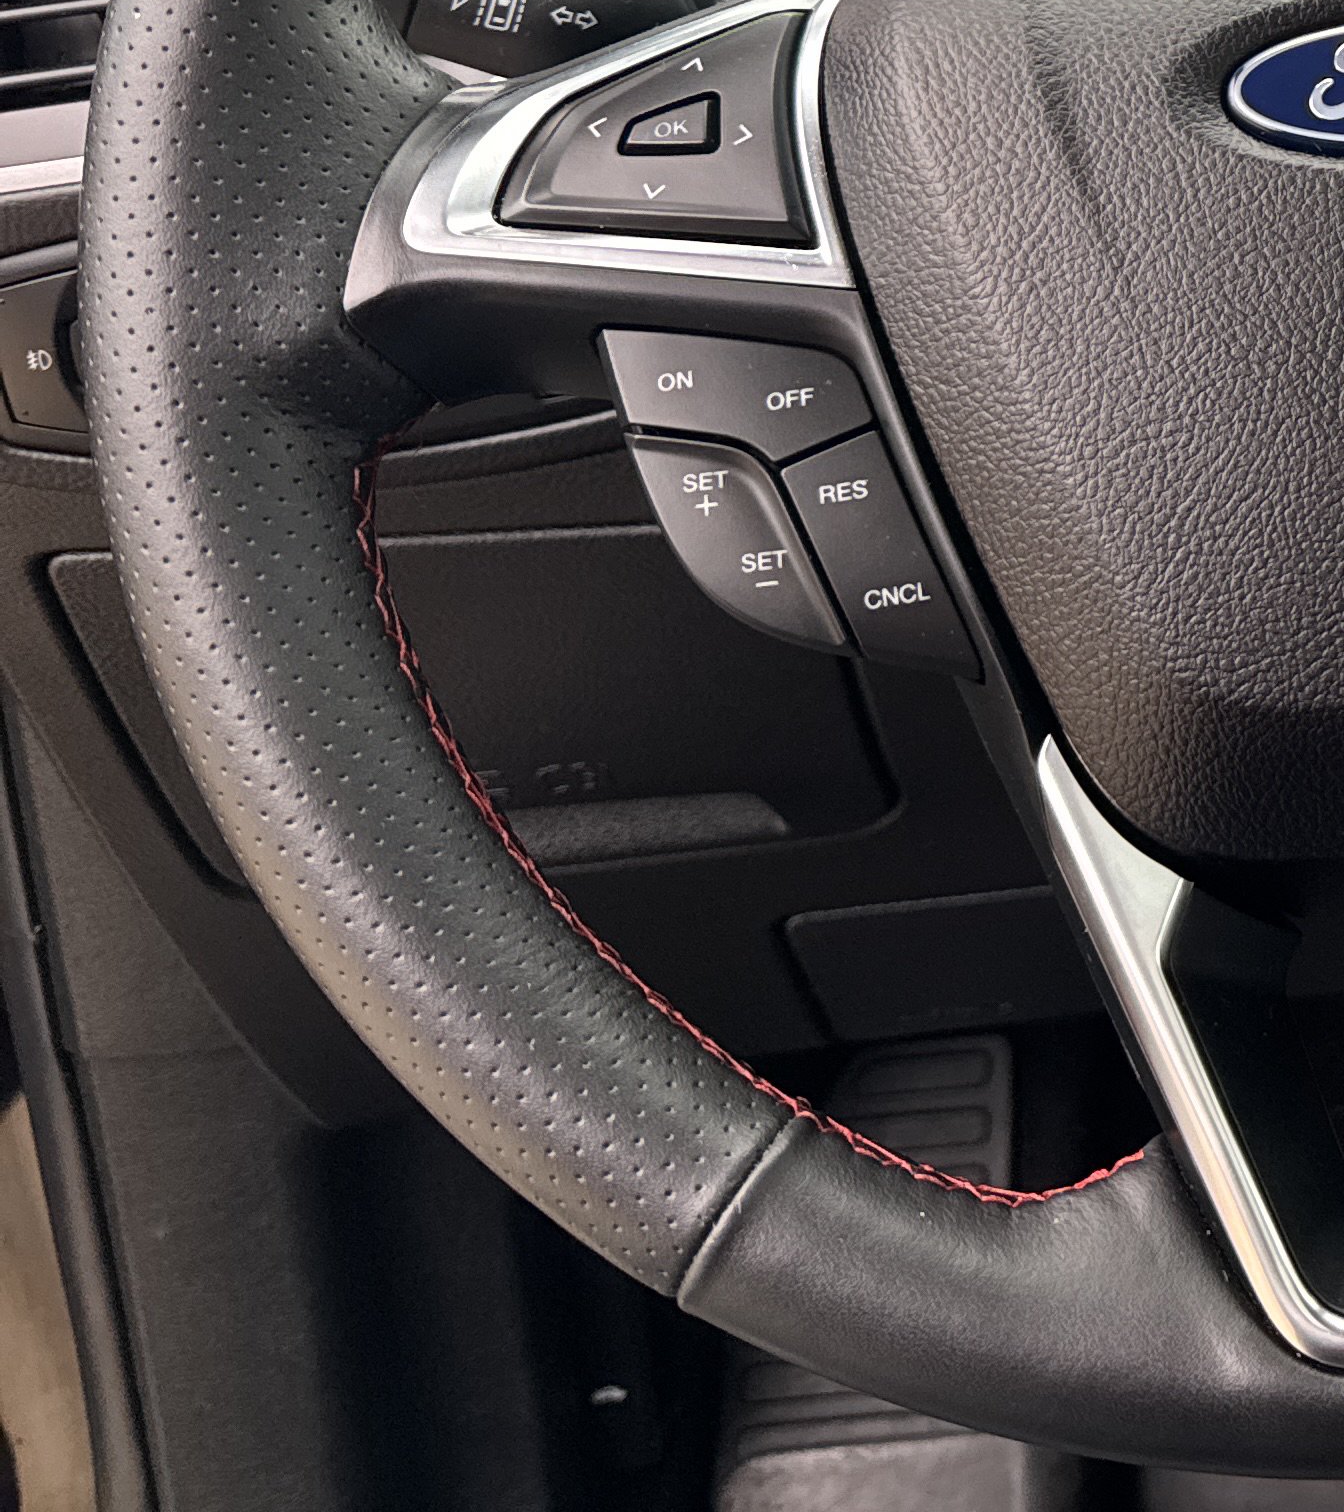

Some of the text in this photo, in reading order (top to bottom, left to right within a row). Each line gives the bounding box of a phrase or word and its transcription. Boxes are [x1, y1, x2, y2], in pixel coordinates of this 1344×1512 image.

[654, 120, 688, 139] OK
[657, 370, 694, 392] ON
[766, 387, 815, 411] OFF
[682, 470, 728, 493] SET
[818, 479, 869, 505] RES
[741, 549, 788, 573] SET
[864, 582, 931, 610] CNCL
